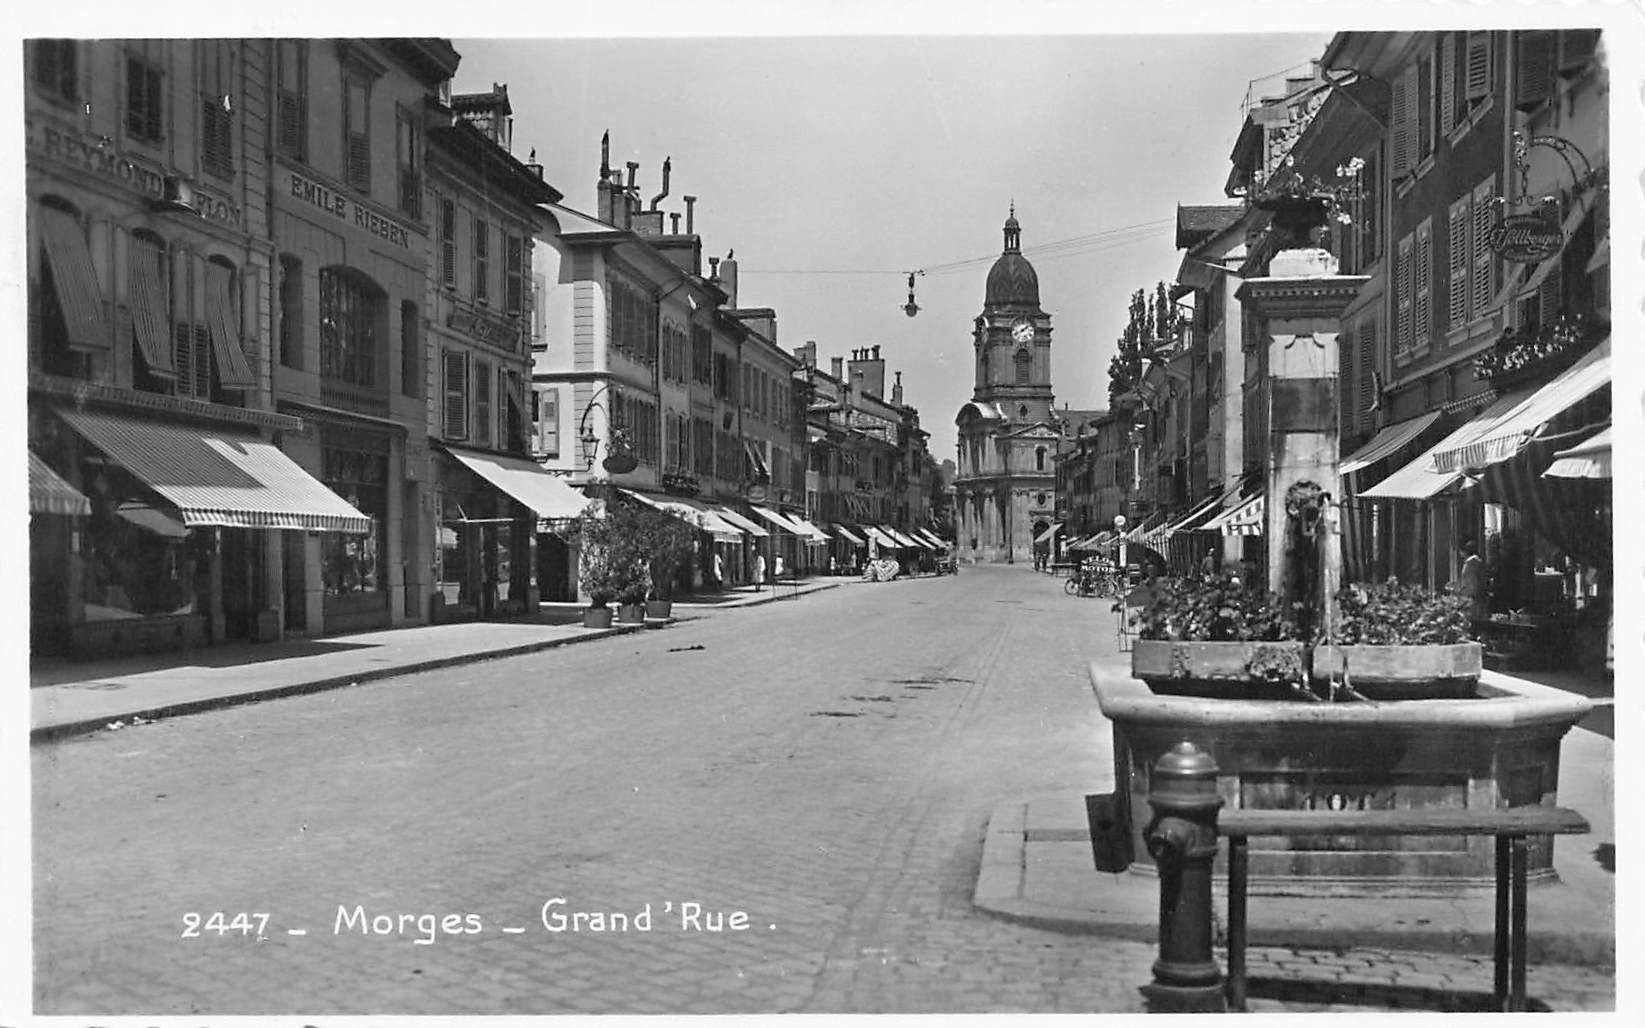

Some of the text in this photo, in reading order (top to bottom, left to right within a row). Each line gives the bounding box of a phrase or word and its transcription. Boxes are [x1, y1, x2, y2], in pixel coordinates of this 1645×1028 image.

[43, 126, 162, 201] REYMOND
[291, 174, 409, 250] EMILE RIEBEN
